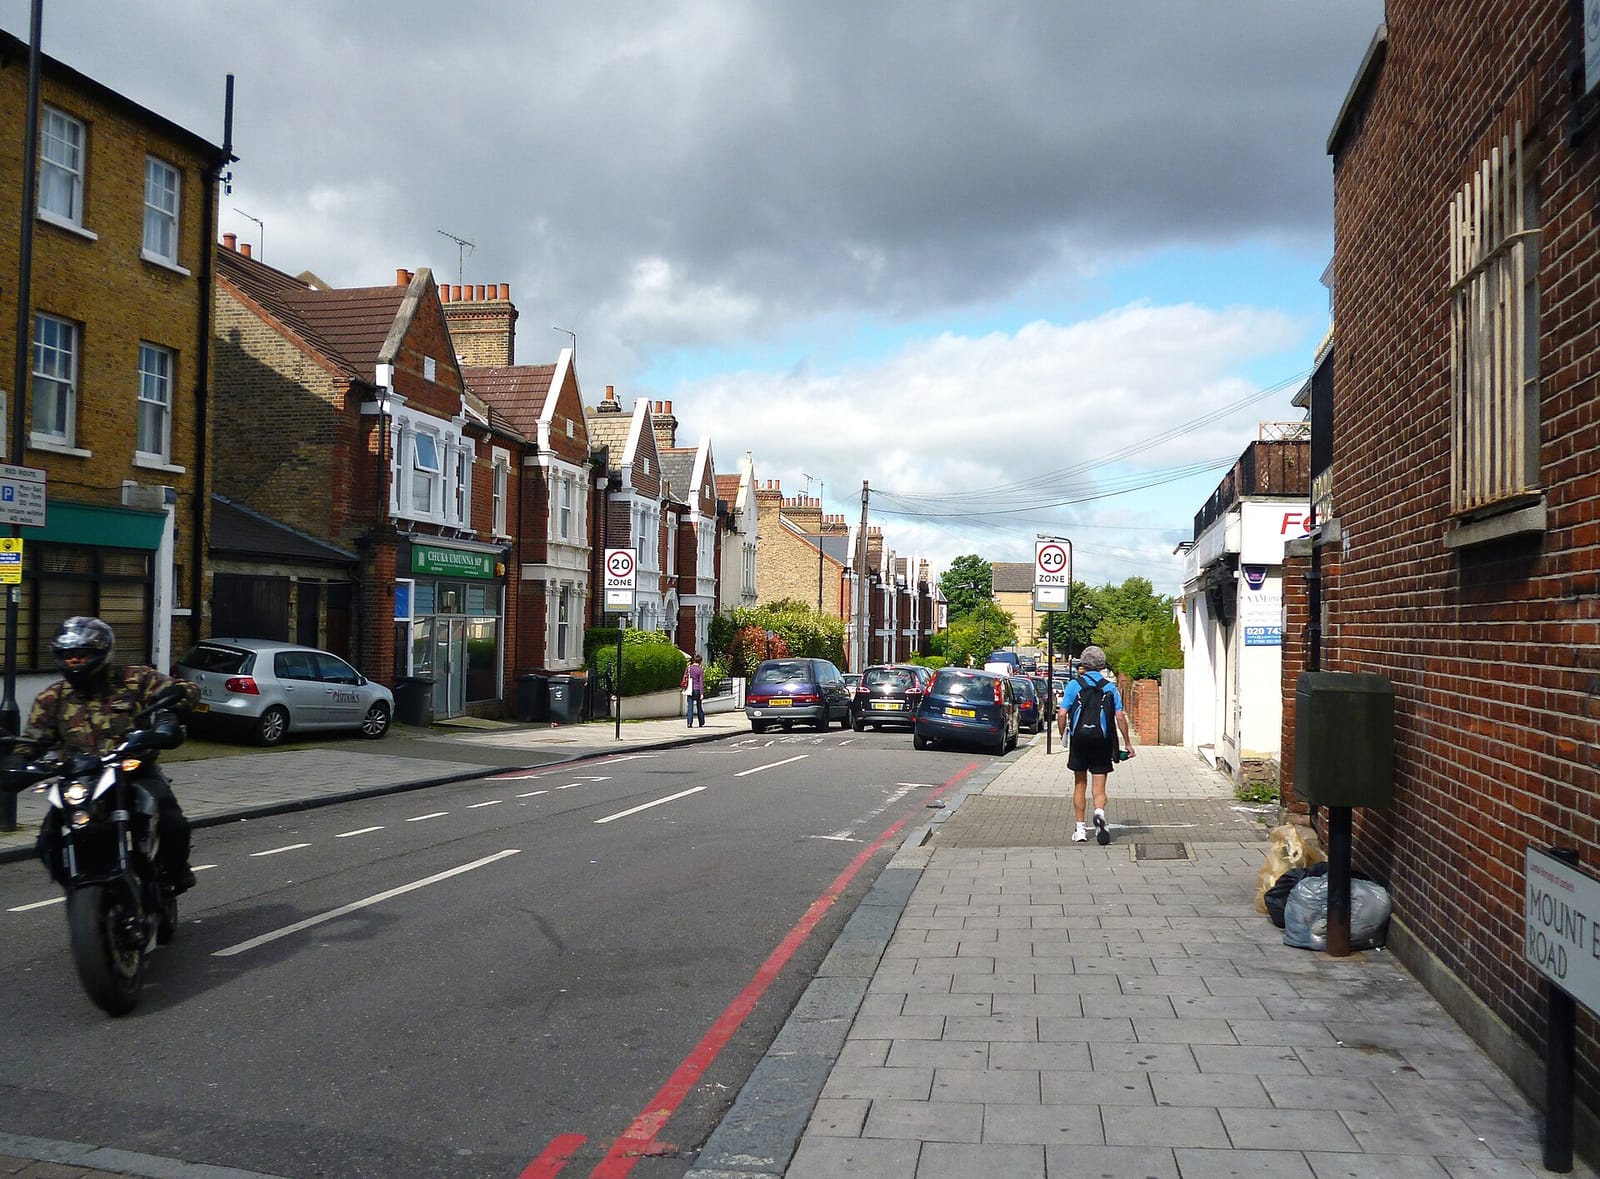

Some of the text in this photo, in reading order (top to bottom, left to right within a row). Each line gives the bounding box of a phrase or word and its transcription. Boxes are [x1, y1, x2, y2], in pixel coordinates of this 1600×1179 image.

[4, 487, 13, 500] P
[427, 551, 449, 563] CHUKA
[449, 553, 474, 566] UMUNNA
[474, 558, 482, 566] MP
[612, 559, 630, 570] 20
[1043, 553, 1063, 565] 20
[1039, 575, 1065, 583] ZONE
[1247, 627, 1265, 635] 020
[1530, 883, 1587, 949] MOUNT
[1530, 924, 1568, 980] ROAD
